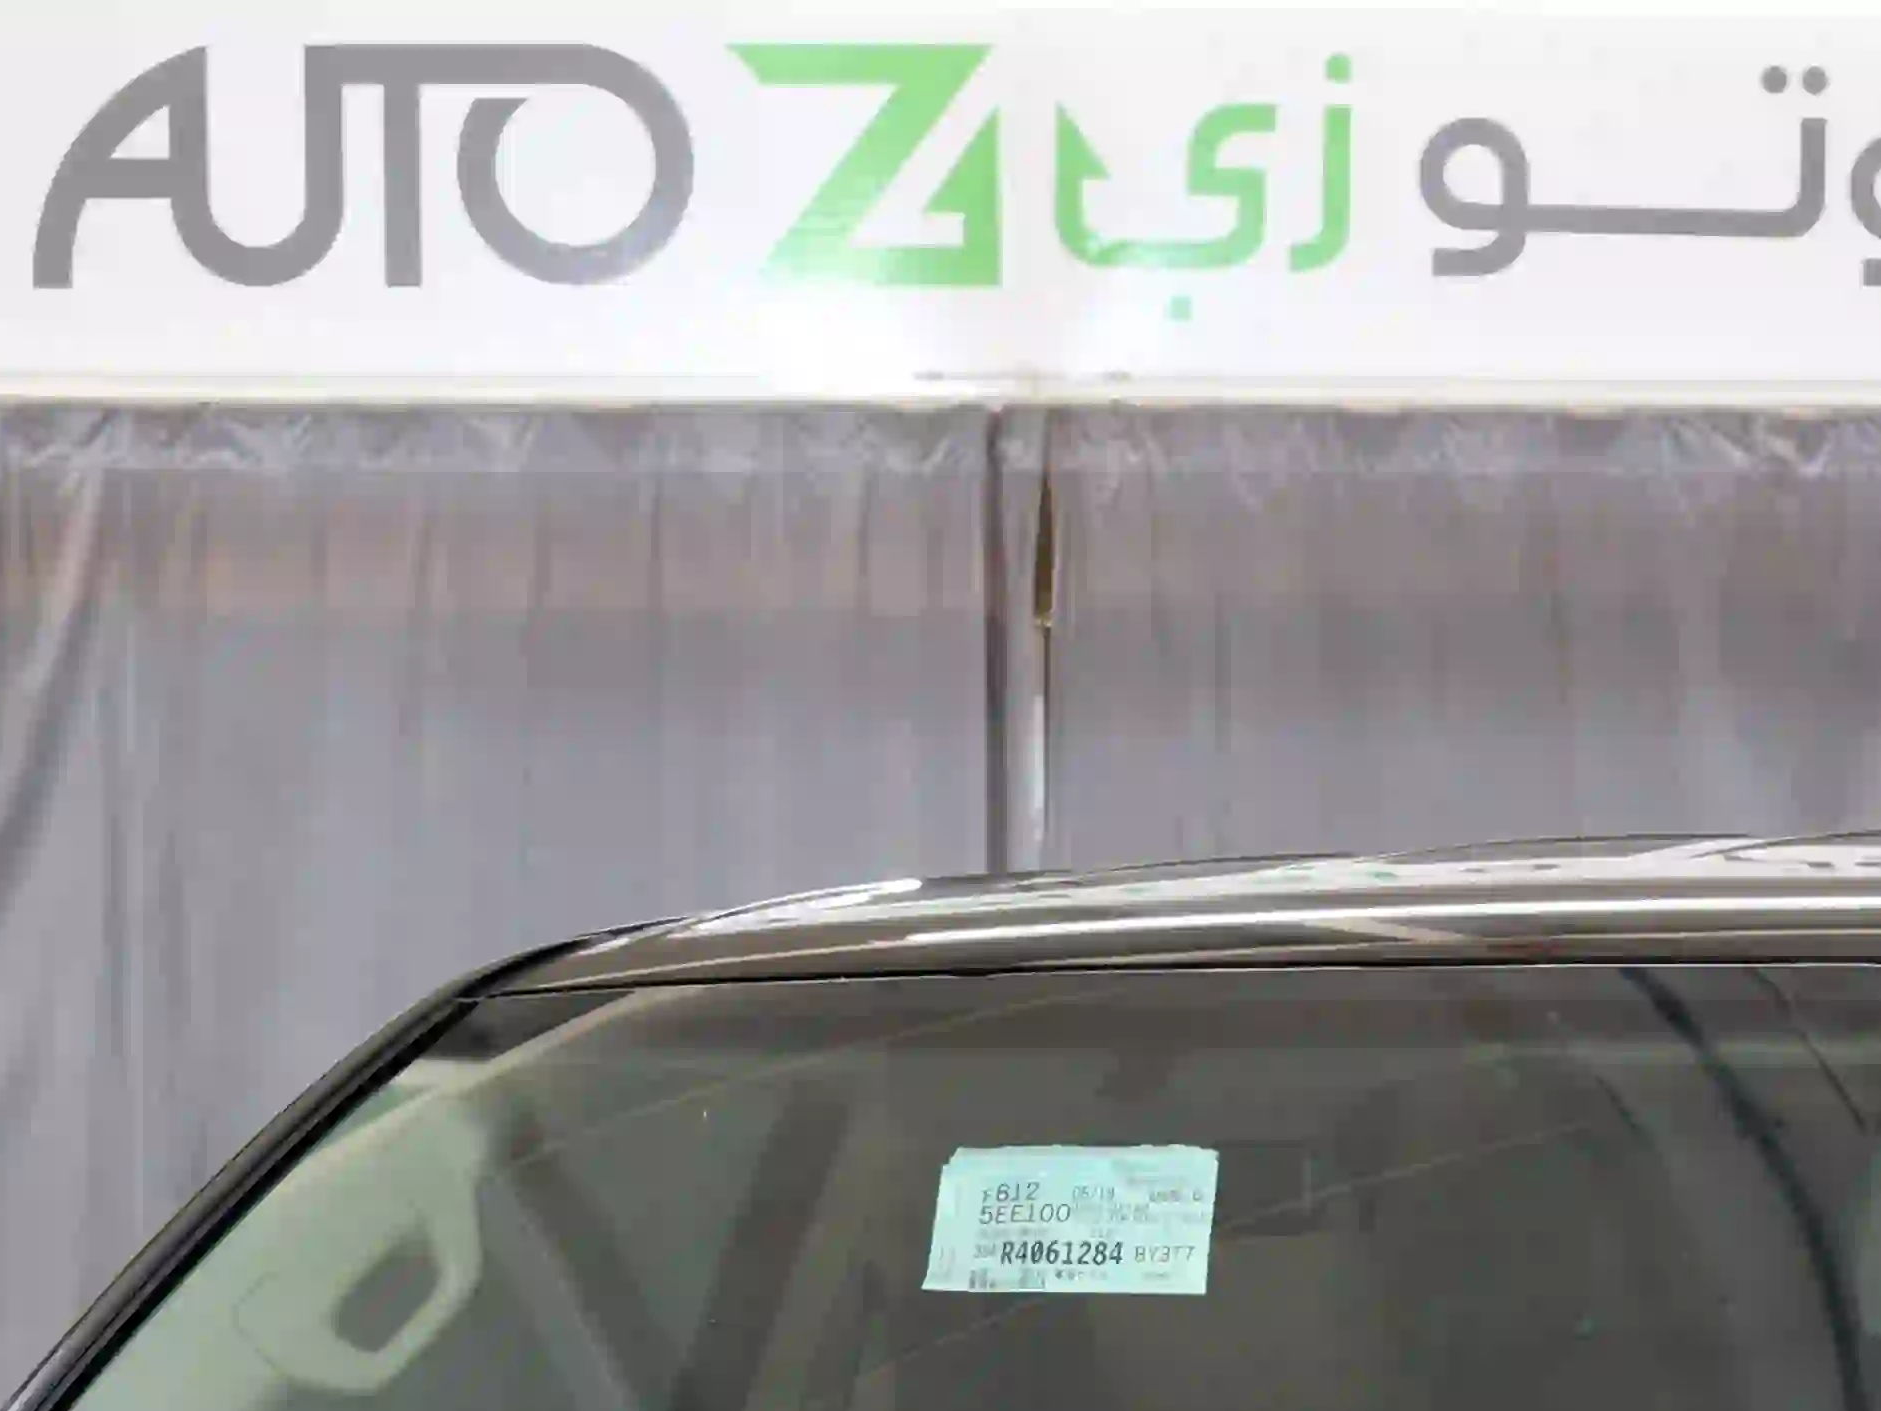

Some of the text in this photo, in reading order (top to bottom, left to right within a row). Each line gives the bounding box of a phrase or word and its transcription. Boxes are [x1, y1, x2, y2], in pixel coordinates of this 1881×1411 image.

[32, 43, 694, 289] AUTO
[1055, 55, 1352, 318] زي
[999, 1240, 1124, 1266] R4061284
